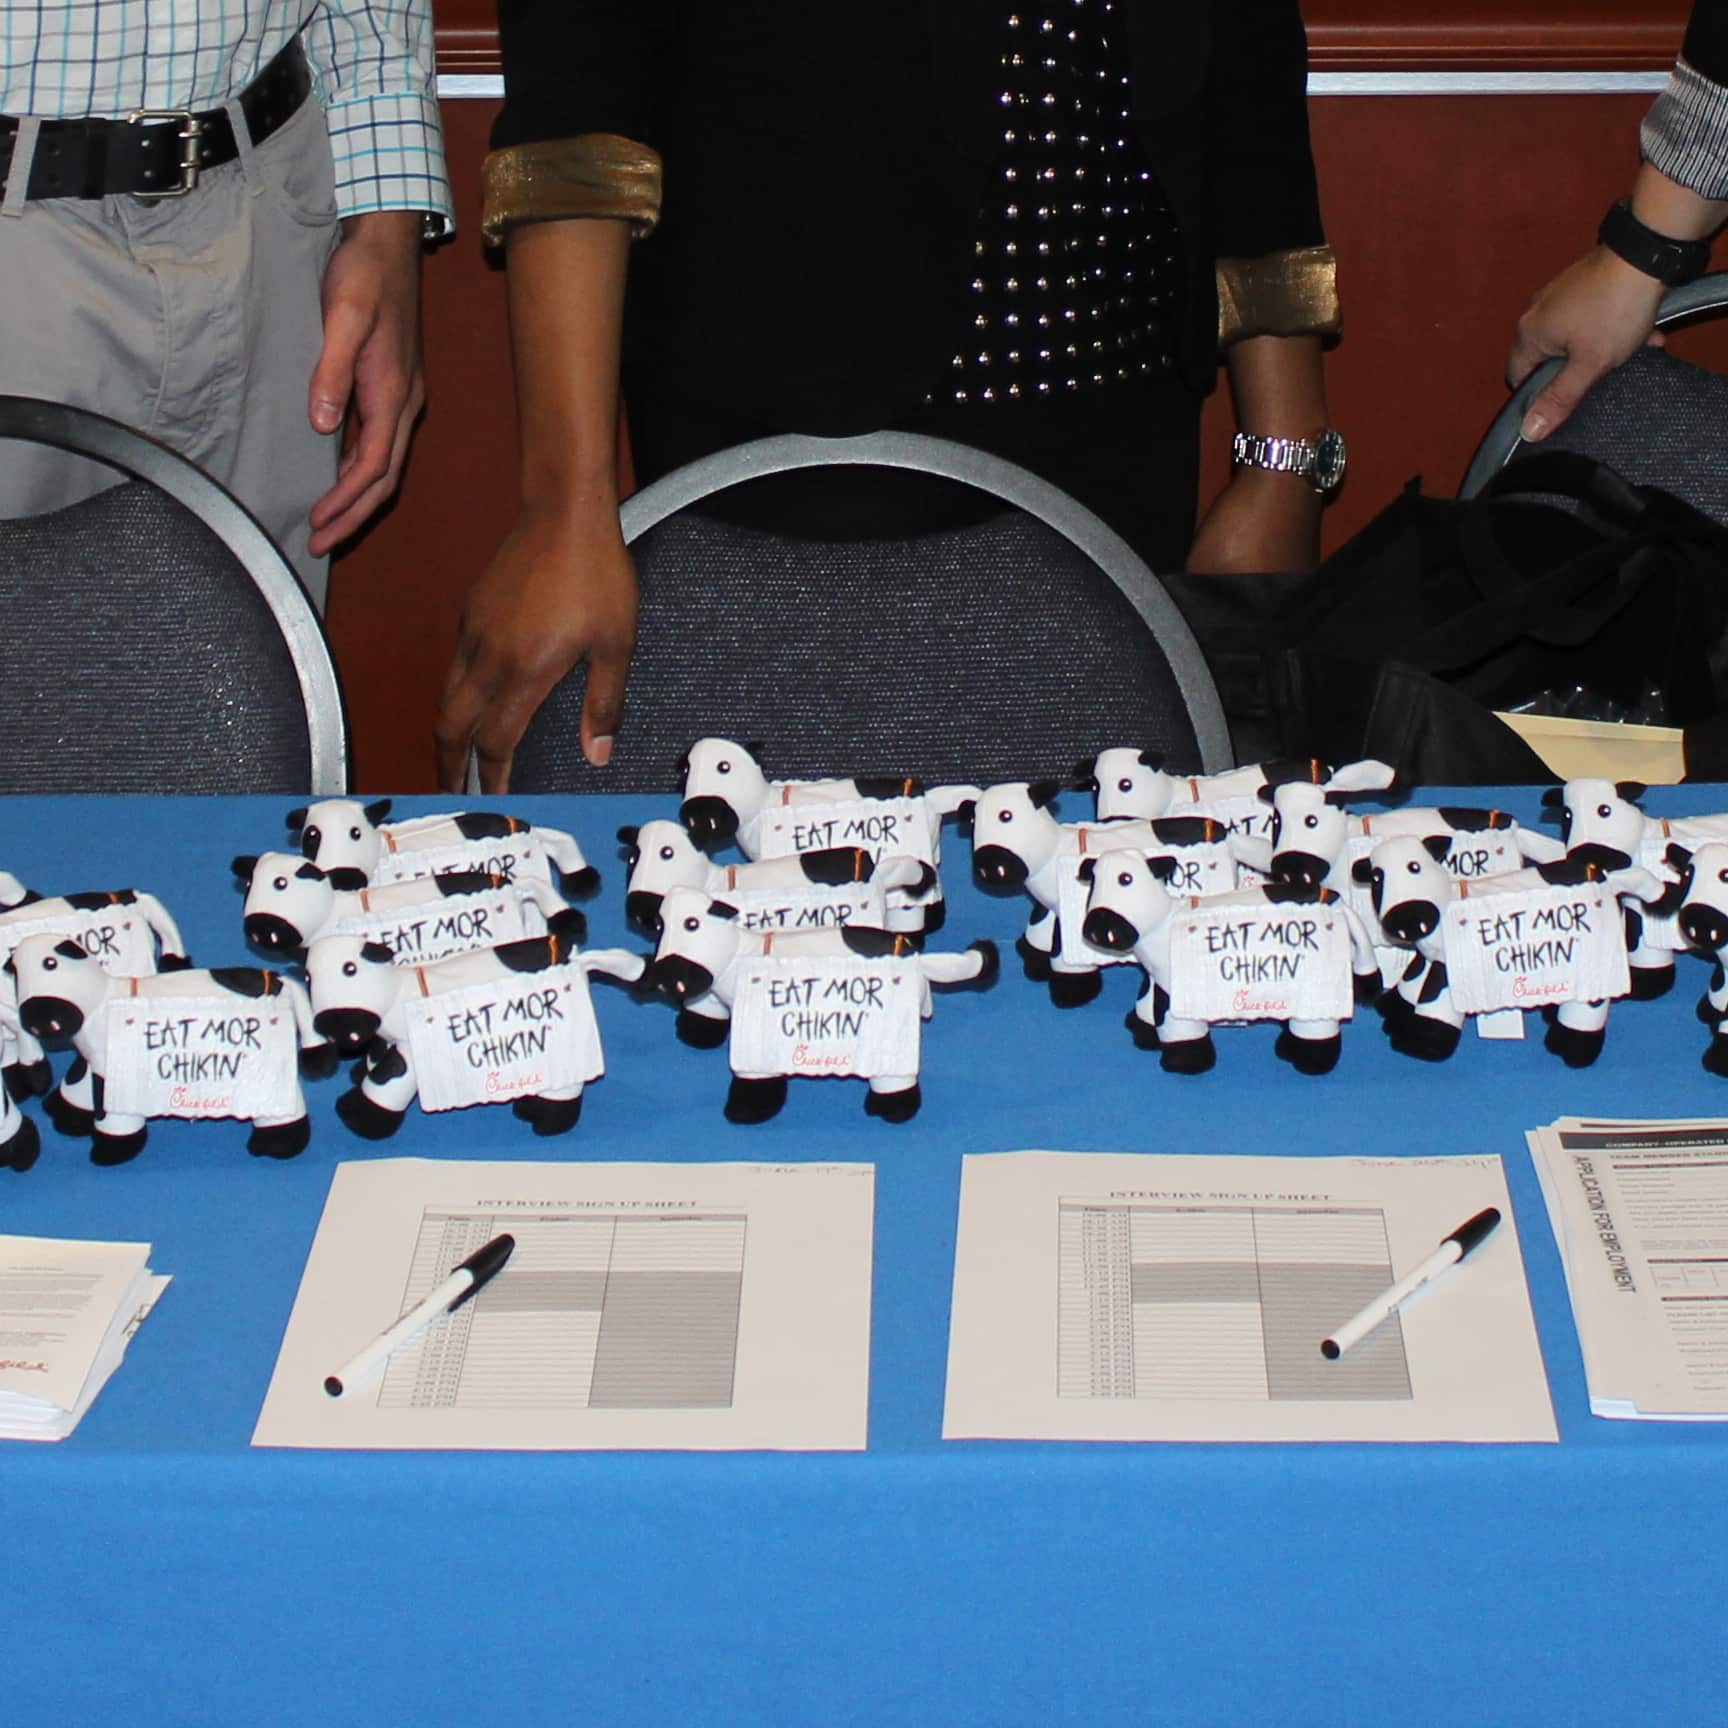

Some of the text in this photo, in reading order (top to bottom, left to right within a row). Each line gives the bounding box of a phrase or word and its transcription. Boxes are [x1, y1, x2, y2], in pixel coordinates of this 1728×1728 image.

[792, 815, 899, 851] EAT MOR
[433, 907, 493, 939] MOR
[1205, 920, 1319, 953] EAT MOR
[1478, 903, 1592, 946] EAT MOR
[1220, 953, 1302, 984] CHIKIN
[1495, 936, 1575, 973] CHIKIN
[768, 976, 885, 1008] EAT MOR
[447, 988, 563, 1043] EAT MOR
[781, 1010, 867, 1040] CHIKIN
[144, 1017, 262, 1050] EAT MOR
[467, 1024, 547, 1068] CHIKIN
[157, 1051, 243, 1083] CHIKIN
[1574, 1155, 1636, 1294] APPLICATION FOR EMPLOYMENT
